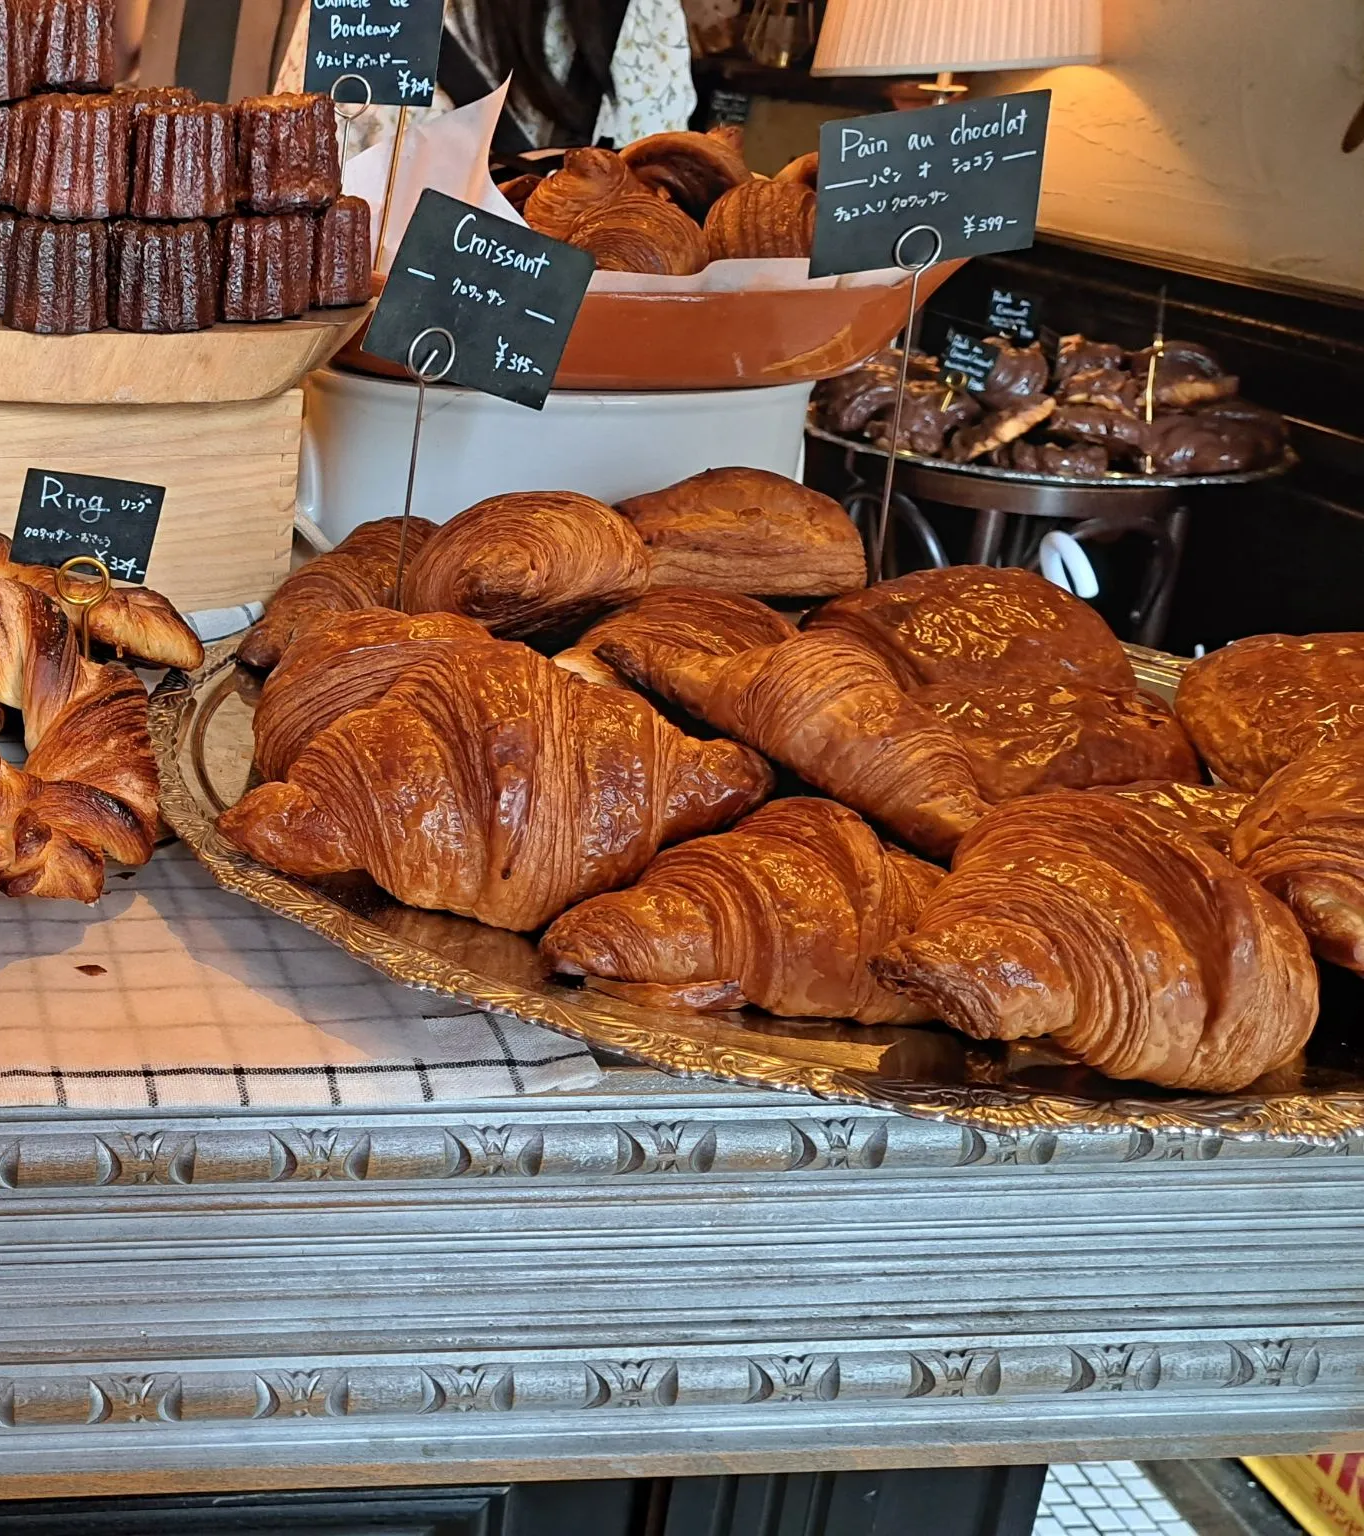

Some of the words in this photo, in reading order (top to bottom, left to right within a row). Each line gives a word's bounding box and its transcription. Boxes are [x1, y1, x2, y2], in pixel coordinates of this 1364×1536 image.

[330, 13, 401, 40] Bordeaux
[841, 128, 888, 162] Pain
[907, 133, 935, 151] au
[950, 102, 1029, 145] chocolat
[868, 166, 902, 188] パン
[951, 151, 995, 174] ショコラ
[453, 213, 550, 279] Croissant
[40, 475, 111, 523] Ring
[120, 498, 153, 513] リング
